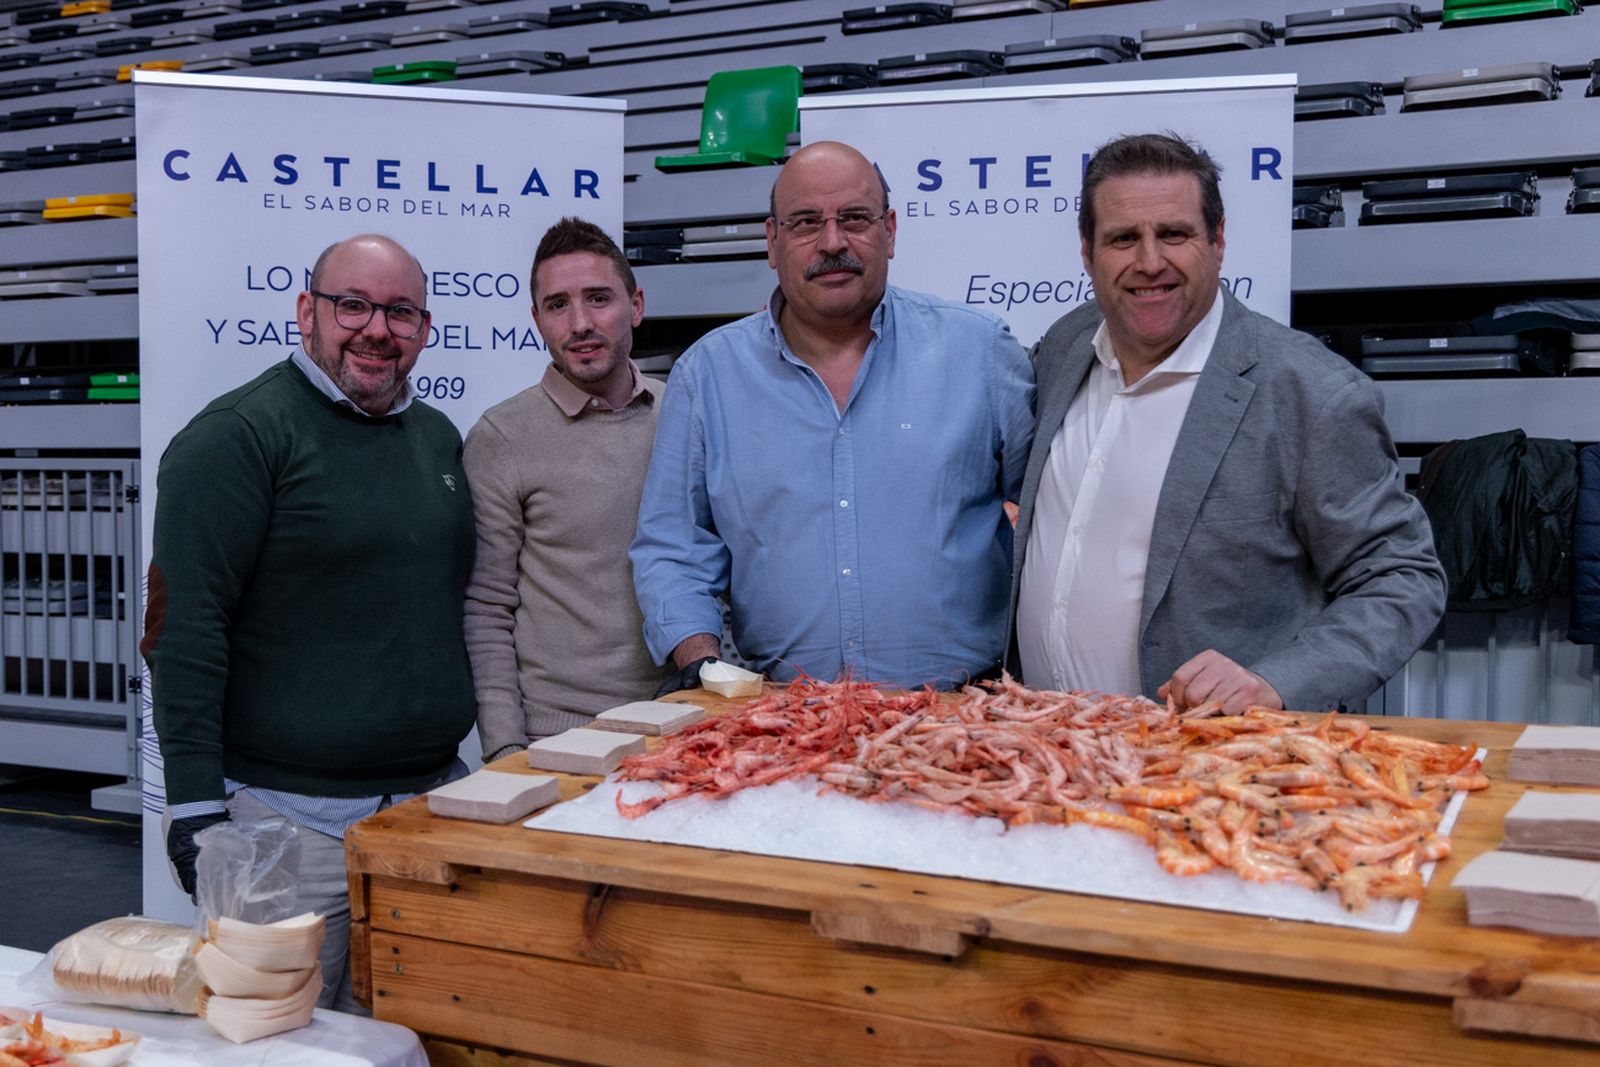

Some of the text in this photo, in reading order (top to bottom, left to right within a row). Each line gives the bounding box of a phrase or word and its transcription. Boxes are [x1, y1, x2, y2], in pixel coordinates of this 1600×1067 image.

[163, 149, 601, 199] CASTELLAR
[264, 194, 511, 219] EL SABOR DEL MAR
[907, 196, 1083, 218] EL SABOR DE
[247, 265, 293, 291] LO
[423, 271, 519, 298] ESCO
[966, 271, 1095, 311] Especia
[206, 319, 228, 344] Y
[492, 326, 547, 352] MA
[408, 376, 466, 400] 969
